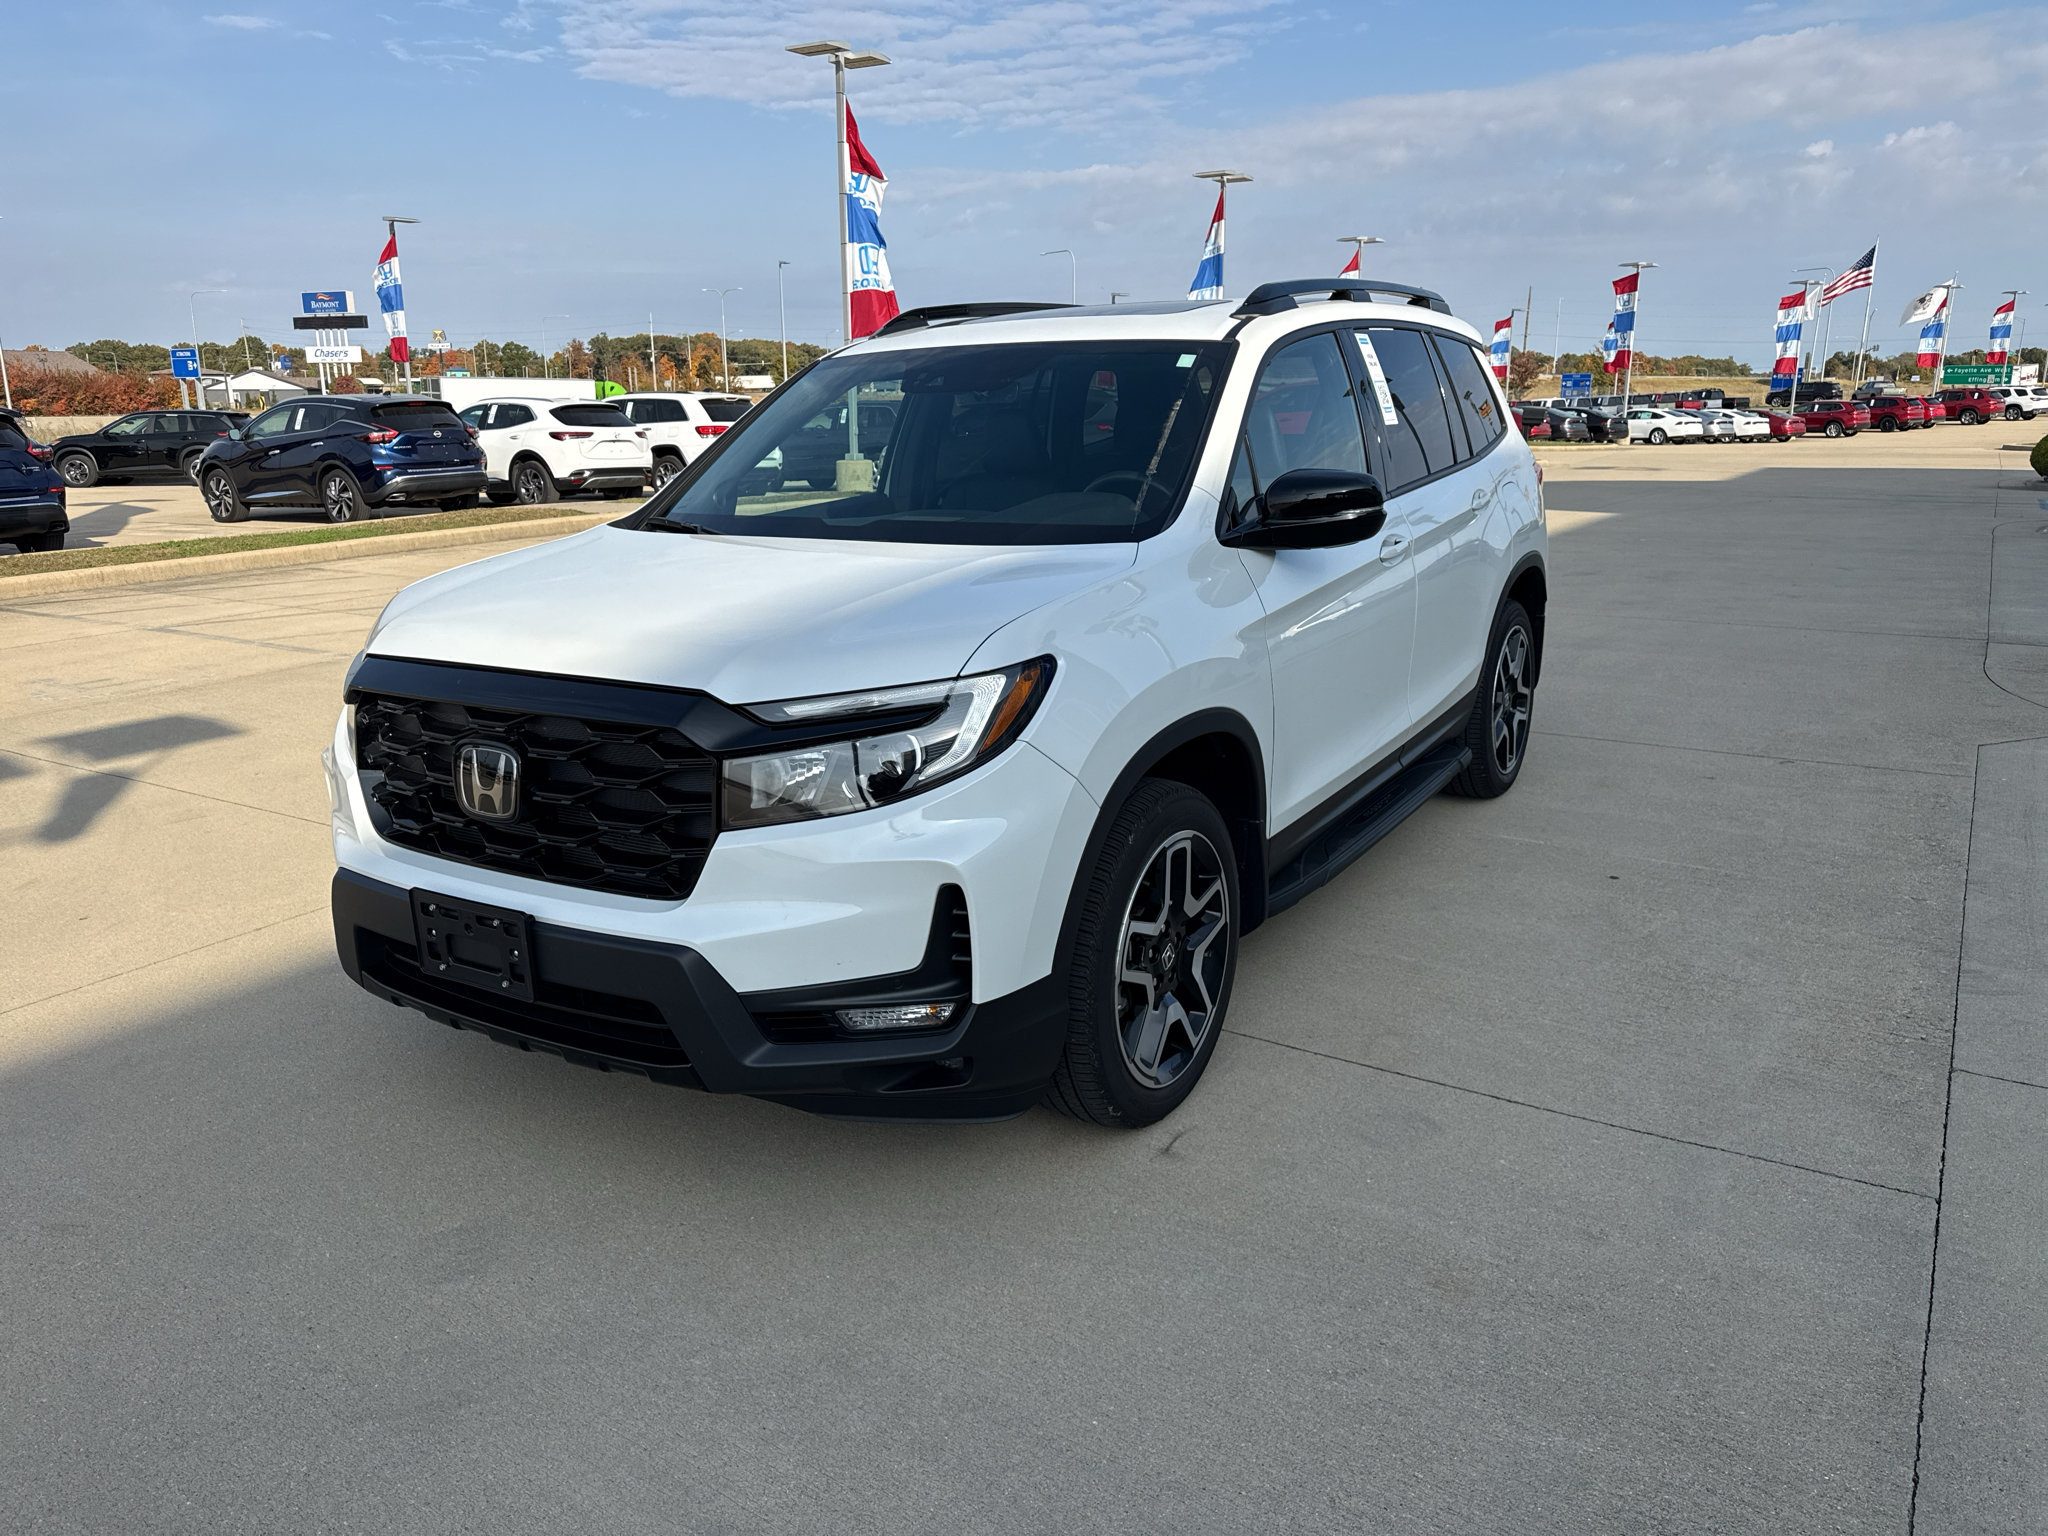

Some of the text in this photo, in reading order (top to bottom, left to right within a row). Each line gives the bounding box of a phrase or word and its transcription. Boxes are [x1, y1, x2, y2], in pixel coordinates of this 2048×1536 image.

[311, 300, 339, 309] BAYMONT
[314, 348, 349, 358] Chasers
[1954, 367, 1978, 375] Fayette
[1968, 376, 2001, 384] Effingm
